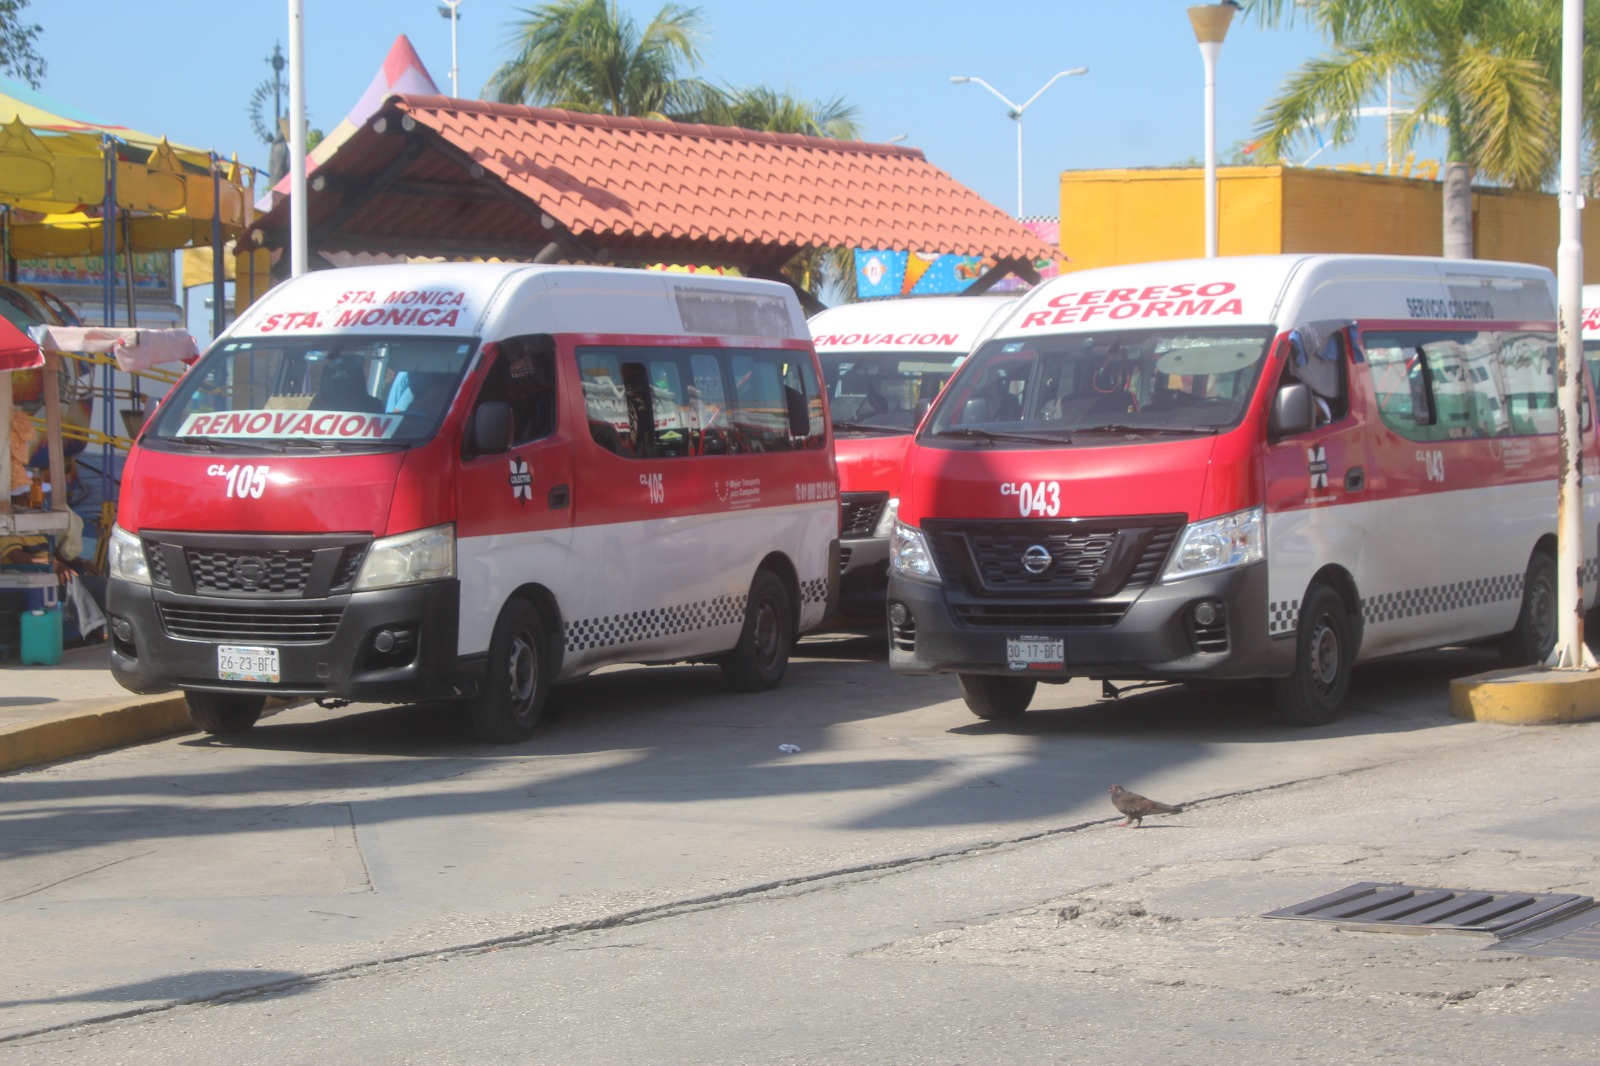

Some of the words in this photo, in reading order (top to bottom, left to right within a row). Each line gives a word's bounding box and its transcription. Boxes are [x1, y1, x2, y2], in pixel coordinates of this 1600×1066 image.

[337, 291, 376, 304] STA.
[383, 291, 466, 306] MONICA
[1047, 282, 1236, 308] CERESO
[261, 312, 323, 332] STA.
[334, 308, 460, 328] MONICA
[1020, 298, 1243, 328] REFORMA
[1406, 298, 1448, 318] SERVICIO
[1449, 300, 1495, 319] COLECTIVO
[812, 333, 959, 347] ENOVACION
[186, 412, 393, 438] RENOVACION
[1425, 450, 1445, 482] 043
[207, 464, 227, 476] CL
[226, 464, 270, 499] 105
[510, 474, 531, 484] COLECTIVO
[639, 473, 649, 485] CL
[648, 473, 664, 504] 105
[1000, 482, 1020, 495] CL
[1019, 481, 1061, 517] 043
[220, 655, 277, 672] 26-23-BFC
[1008, 644, 1063, 659] 30-17-BFC
